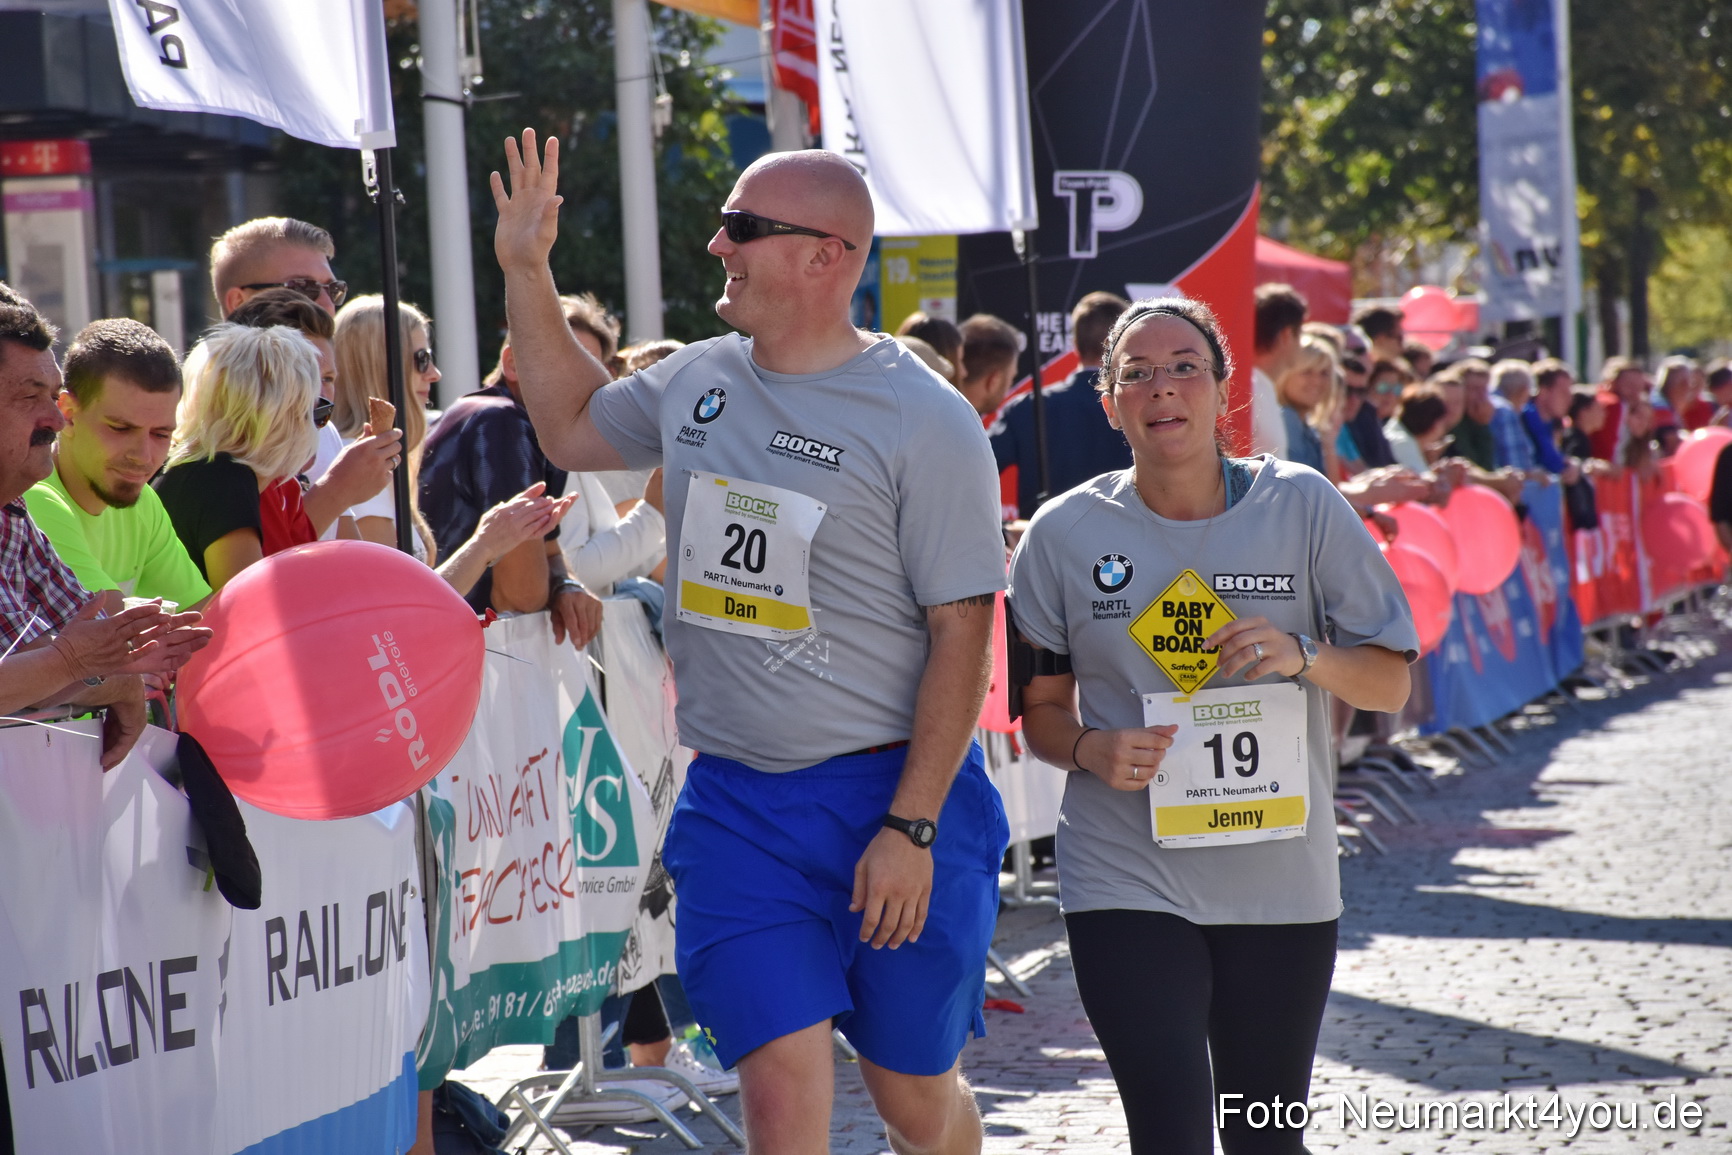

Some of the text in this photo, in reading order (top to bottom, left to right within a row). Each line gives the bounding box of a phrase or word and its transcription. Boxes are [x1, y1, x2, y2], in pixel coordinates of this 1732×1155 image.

[675, 435, 705, 448] Neumarkt
[681, 425, 707, 441] PARTL
[770, 431, 844, 466] BOCK
[766, 447, 840, 472] inspired by smart concepts
[726, 491, 779, 519] BOCK
[686, 548, 692, 557] D
[720, 523, 767, 574] 20
[704, 571, 772, 593] PARTL Neumarkt
[1213, 574, 1295, 594] BOCK
[724, 596, 757, 619] Dan
[1092, 600, 1131, 611] PARTL
[1093, 610, 1131, 620] Neumarkt
[1162, 601, 1215, 619] BABY
[1174, 618, 1203, 636] ON
[1171, 663, 1197, 672] Safety
[1193, 700, 1261, 721] BOCK
[1203, 731, 1260, 779] 19
[1158, 774, 1164, 783] D
[1186, 785, 1268, 798] PARTL Neumarkt
[1208, 809, 1264, 829] Jenny
[607, 876, 637, 893] GmbH
[265, 878, 409, 1006] RAIL.ONE
